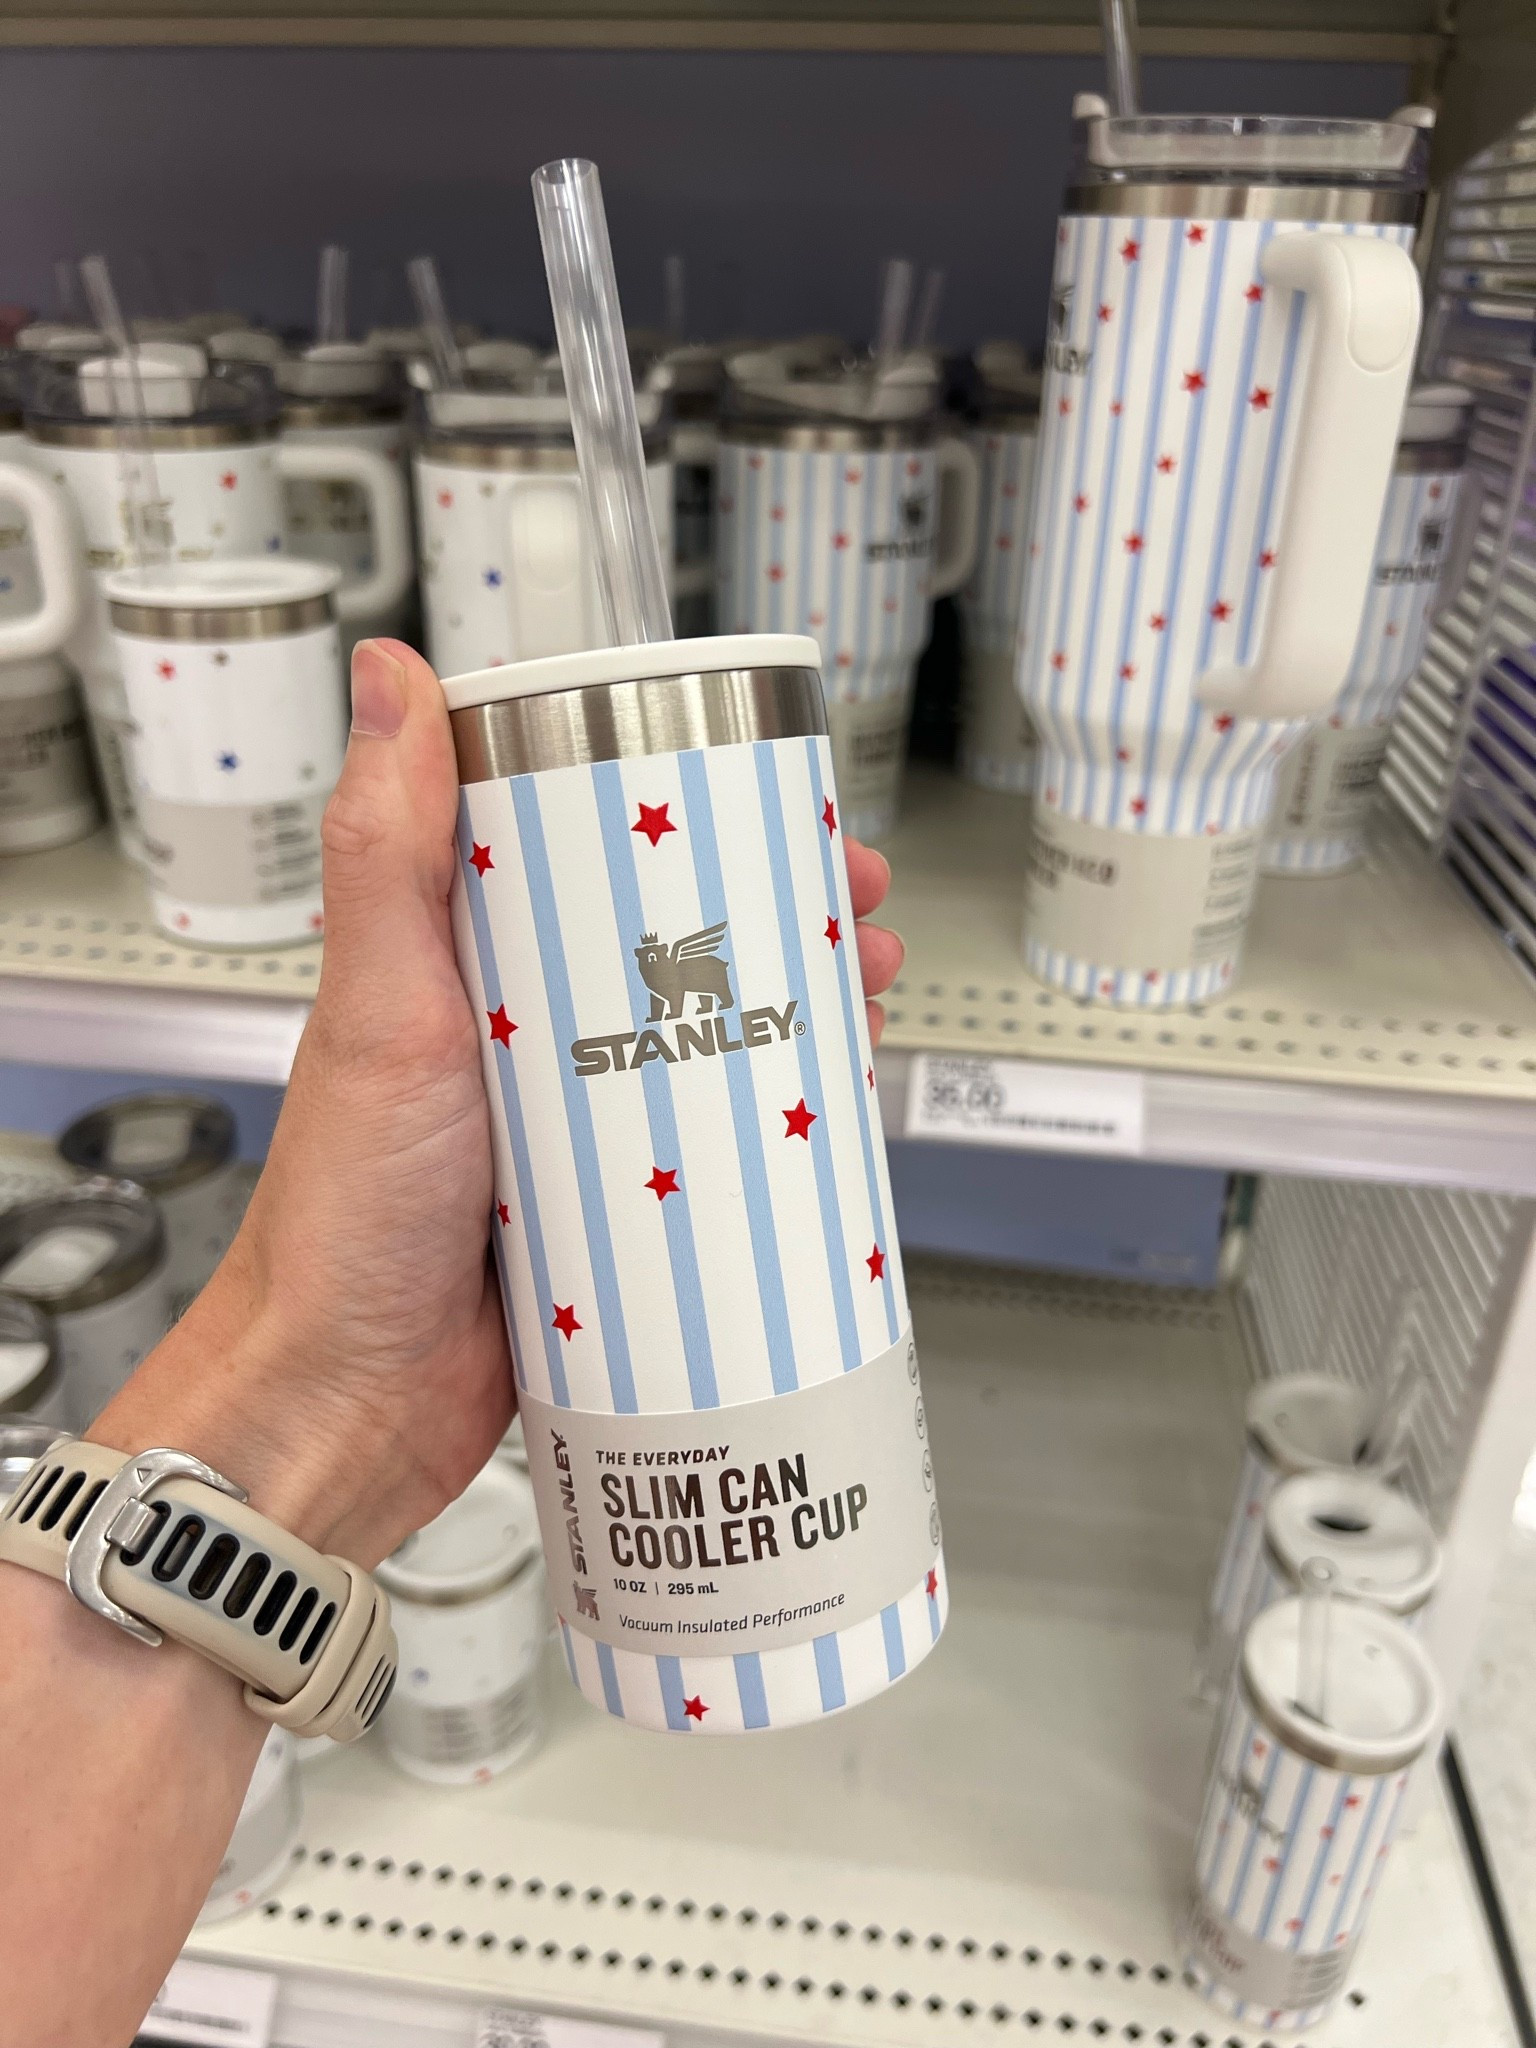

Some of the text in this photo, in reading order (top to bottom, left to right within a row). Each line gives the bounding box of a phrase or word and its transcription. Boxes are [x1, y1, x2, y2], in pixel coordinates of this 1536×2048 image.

[596, 1445, 730, 1466] THE EVERYDAY
[601, 1452, 809, 1520] SLIM CAN
[608, 1483, 868, 1570] COOLER CUP
[613, 1578, 627, 1591] 10
[630, 1580, 647, 1593] OZ
[668, 1582, 695, 1595] 295
[698, 1581, 719, 1594] mL
[619, 1592, 846, 1634] Vacuum Insulated Performance
